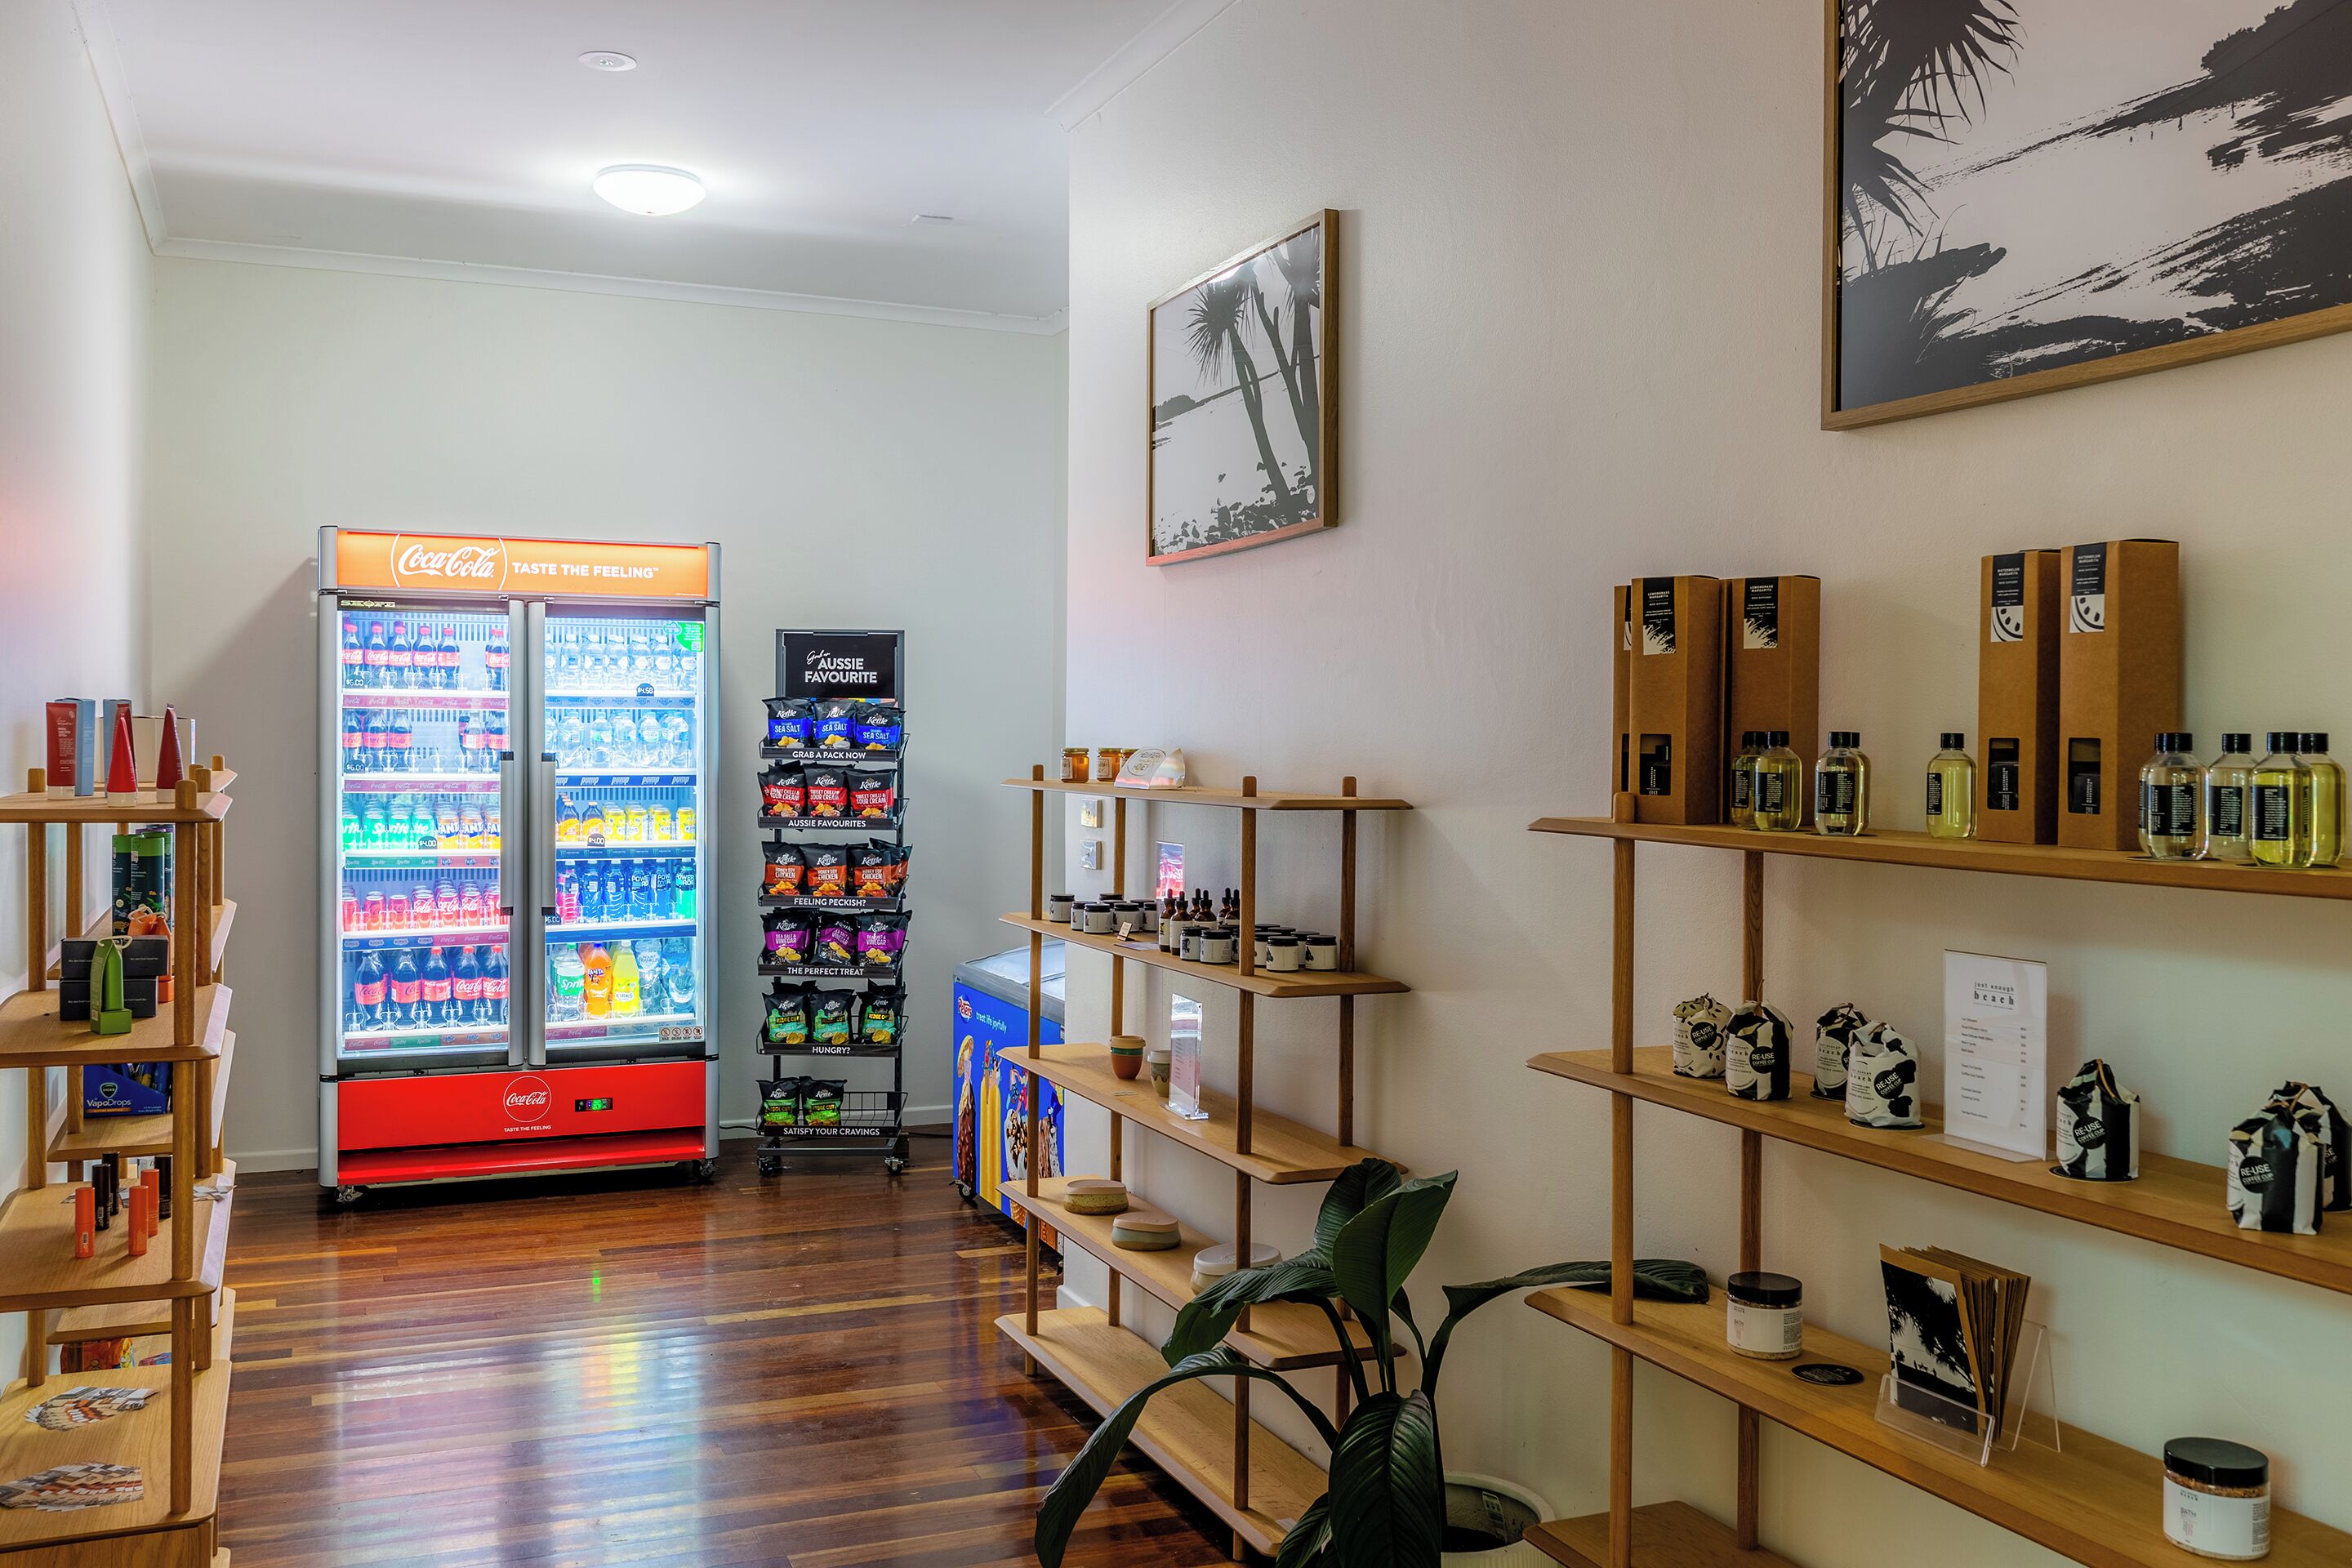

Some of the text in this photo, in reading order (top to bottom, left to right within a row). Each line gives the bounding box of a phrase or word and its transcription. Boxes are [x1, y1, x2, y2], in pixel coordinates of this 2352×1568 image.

[399, 544, 501, 577] Coca-Cola
[512, 562, 557, 575] TASTE
[561, 564, 589, 576] THE
[807, 650, 822, 665] Grab
[817, 658, 864, 670] AUSSIE
[805, 671, 877, 683] FAVOURITE
[776, 709, 796, 718] Kettle
[834, 723, 847, 731] SALT
[866, 716, 889, 726] Kettle
[815, 777, 836, 786] Kettle
[859, 782, 881, 791] Kettle
[776, 857, 796, 865] Kettle
[817, 857, 837, 866] Kettle
[862, 857, 882, 866] Kettle
[776, 920, 797, 930] Kettle
[867, 924, 889, 933] Kettle
[832, 932, 848, 946] VINEGAR
[1974, 991, 2014, 1005] beach
[959, 998, 972, 1018] Peters
[976, 1011, 986, 1023] treat
[992, 1017, 1007, 1035] joyfully
[1692, 1026, 1713, 1038] RE-USE
[1876, 1072, 1899, 1090] RE-USE
[1881, 1083, 1895, 1094] COFFEE
[506, 1091, 548, 1106] Coca-Cola
[840, 1128, 880, 1136] CRAVINGS
[2074, 1120, 2101, 1136] RE-USE
[2240, 1164, 2271, 1176] RE-USE
[2180, 1507, 2196, 1517] BATH
